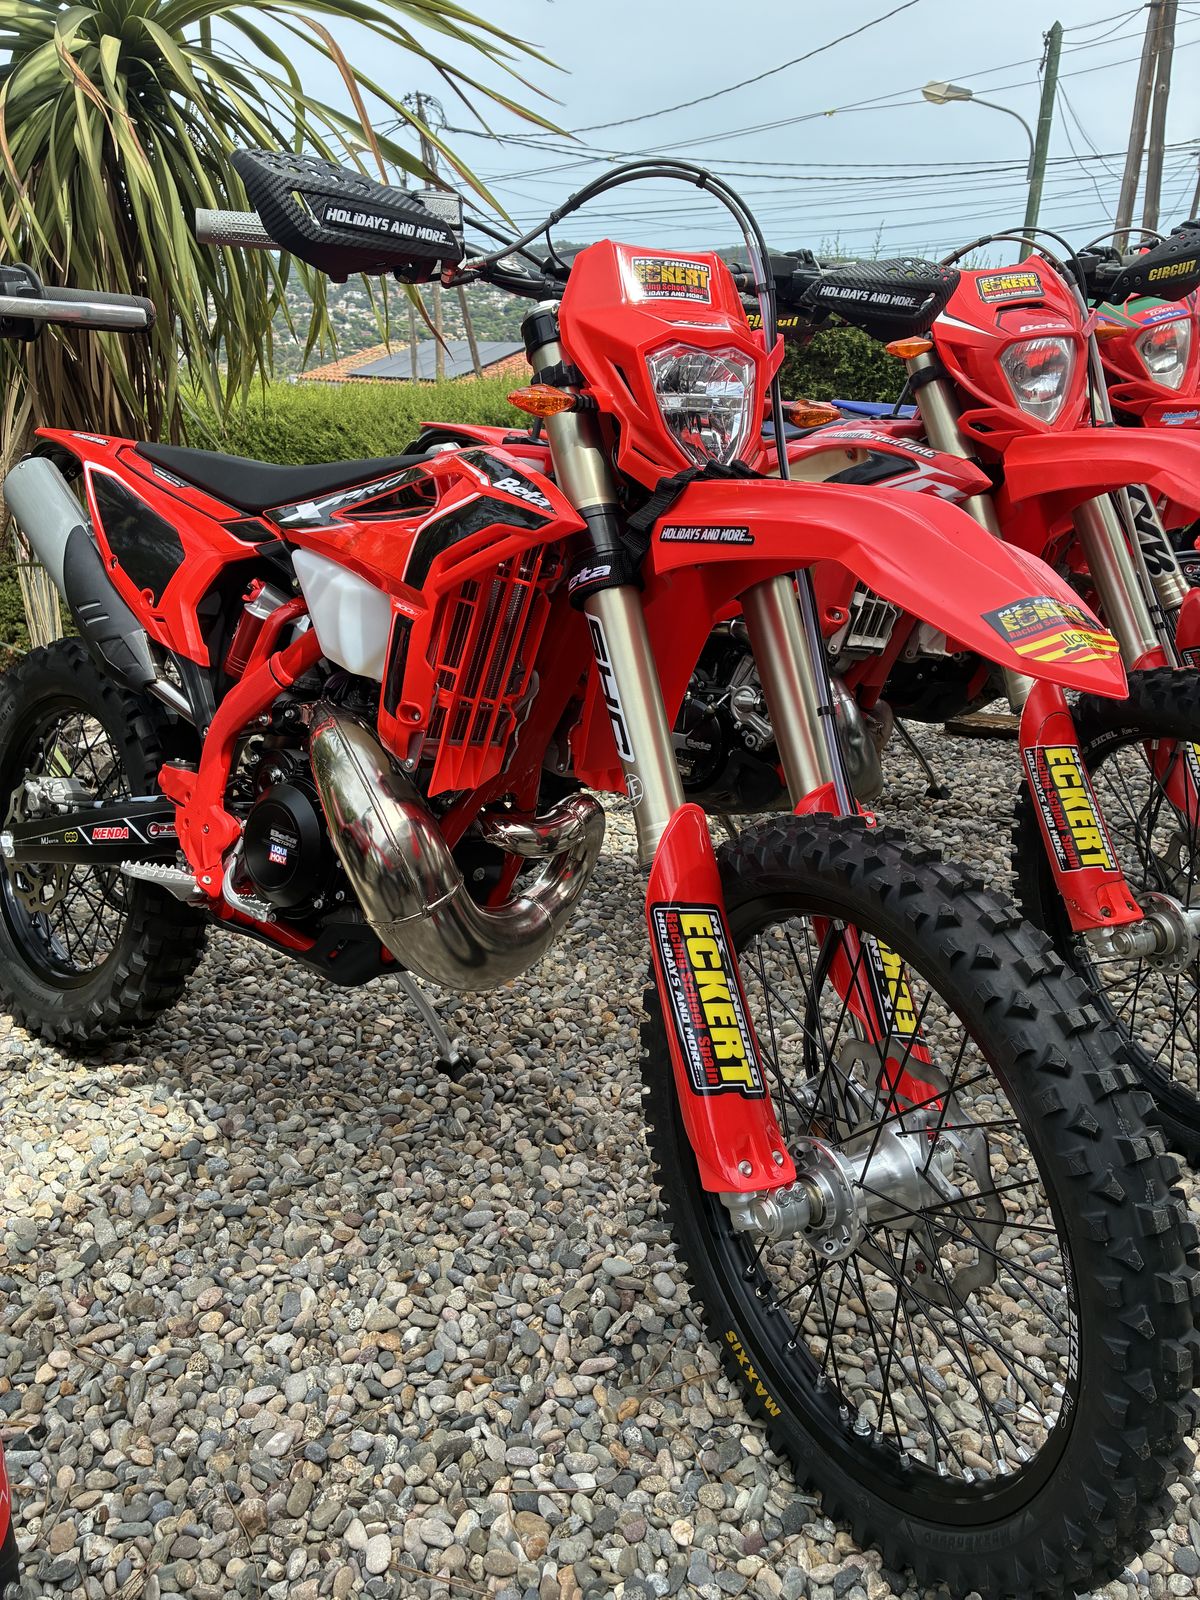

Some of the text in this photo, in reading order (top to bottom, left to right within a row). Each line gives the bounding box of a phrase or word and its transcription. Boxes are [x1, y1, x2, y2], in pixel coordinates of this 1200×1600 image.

[326, 207, 390, 231] HOLIDAYS
[390, 220, 415, 237] AND
[634, 264, 710, 289] ECKERT
[663, 260, 709, 272] ENDURO
[1148, 259, 1197, 281] CIRCUIT
[820, 285, 870, 301] HOLIDAYS
[869, 292, 890, 304] AND
[1020, 322, 1067, 333] Beta
[492, 477, 551, 507] Beta
[661, 527, 702, 540] HOLIDAYS
[700, 528, 720, 541] AND
[568, 563, 612, 591] eta
[1008, 624, 1044, 639] Racing
[1090, 730, 1118, 749] EXCEL
[1025, 750, 1047, 803] HOLIDAYS
[1041, 804, 1055, 828] AND
[1044, 747, 1112, 869] ECKERT
[92, 827, 129, 840] KENDA
[1047, 790, 1070, 831] School
[1061, 834, 1080, 869] Spain
[1086, 792, 1117, 869] ENDURO
[269, 852, 287, 866] MOLY
[271, 844, 288, 856] LIQUI
[656, 911, 682, 988] HOLIDAYS
[674, 990, 690, 1025] AND
[665, 912, 720, 1085] Racing School Spain
[679, 913, 755, 1088] ECKERT
[708, 914, 726, 954] MX
[726, 977, 760, 1087] ENDURO
[1068, 1307, 1079, 1382] EXCEL
[724, 1330, 782, 1418] MAXXIS
